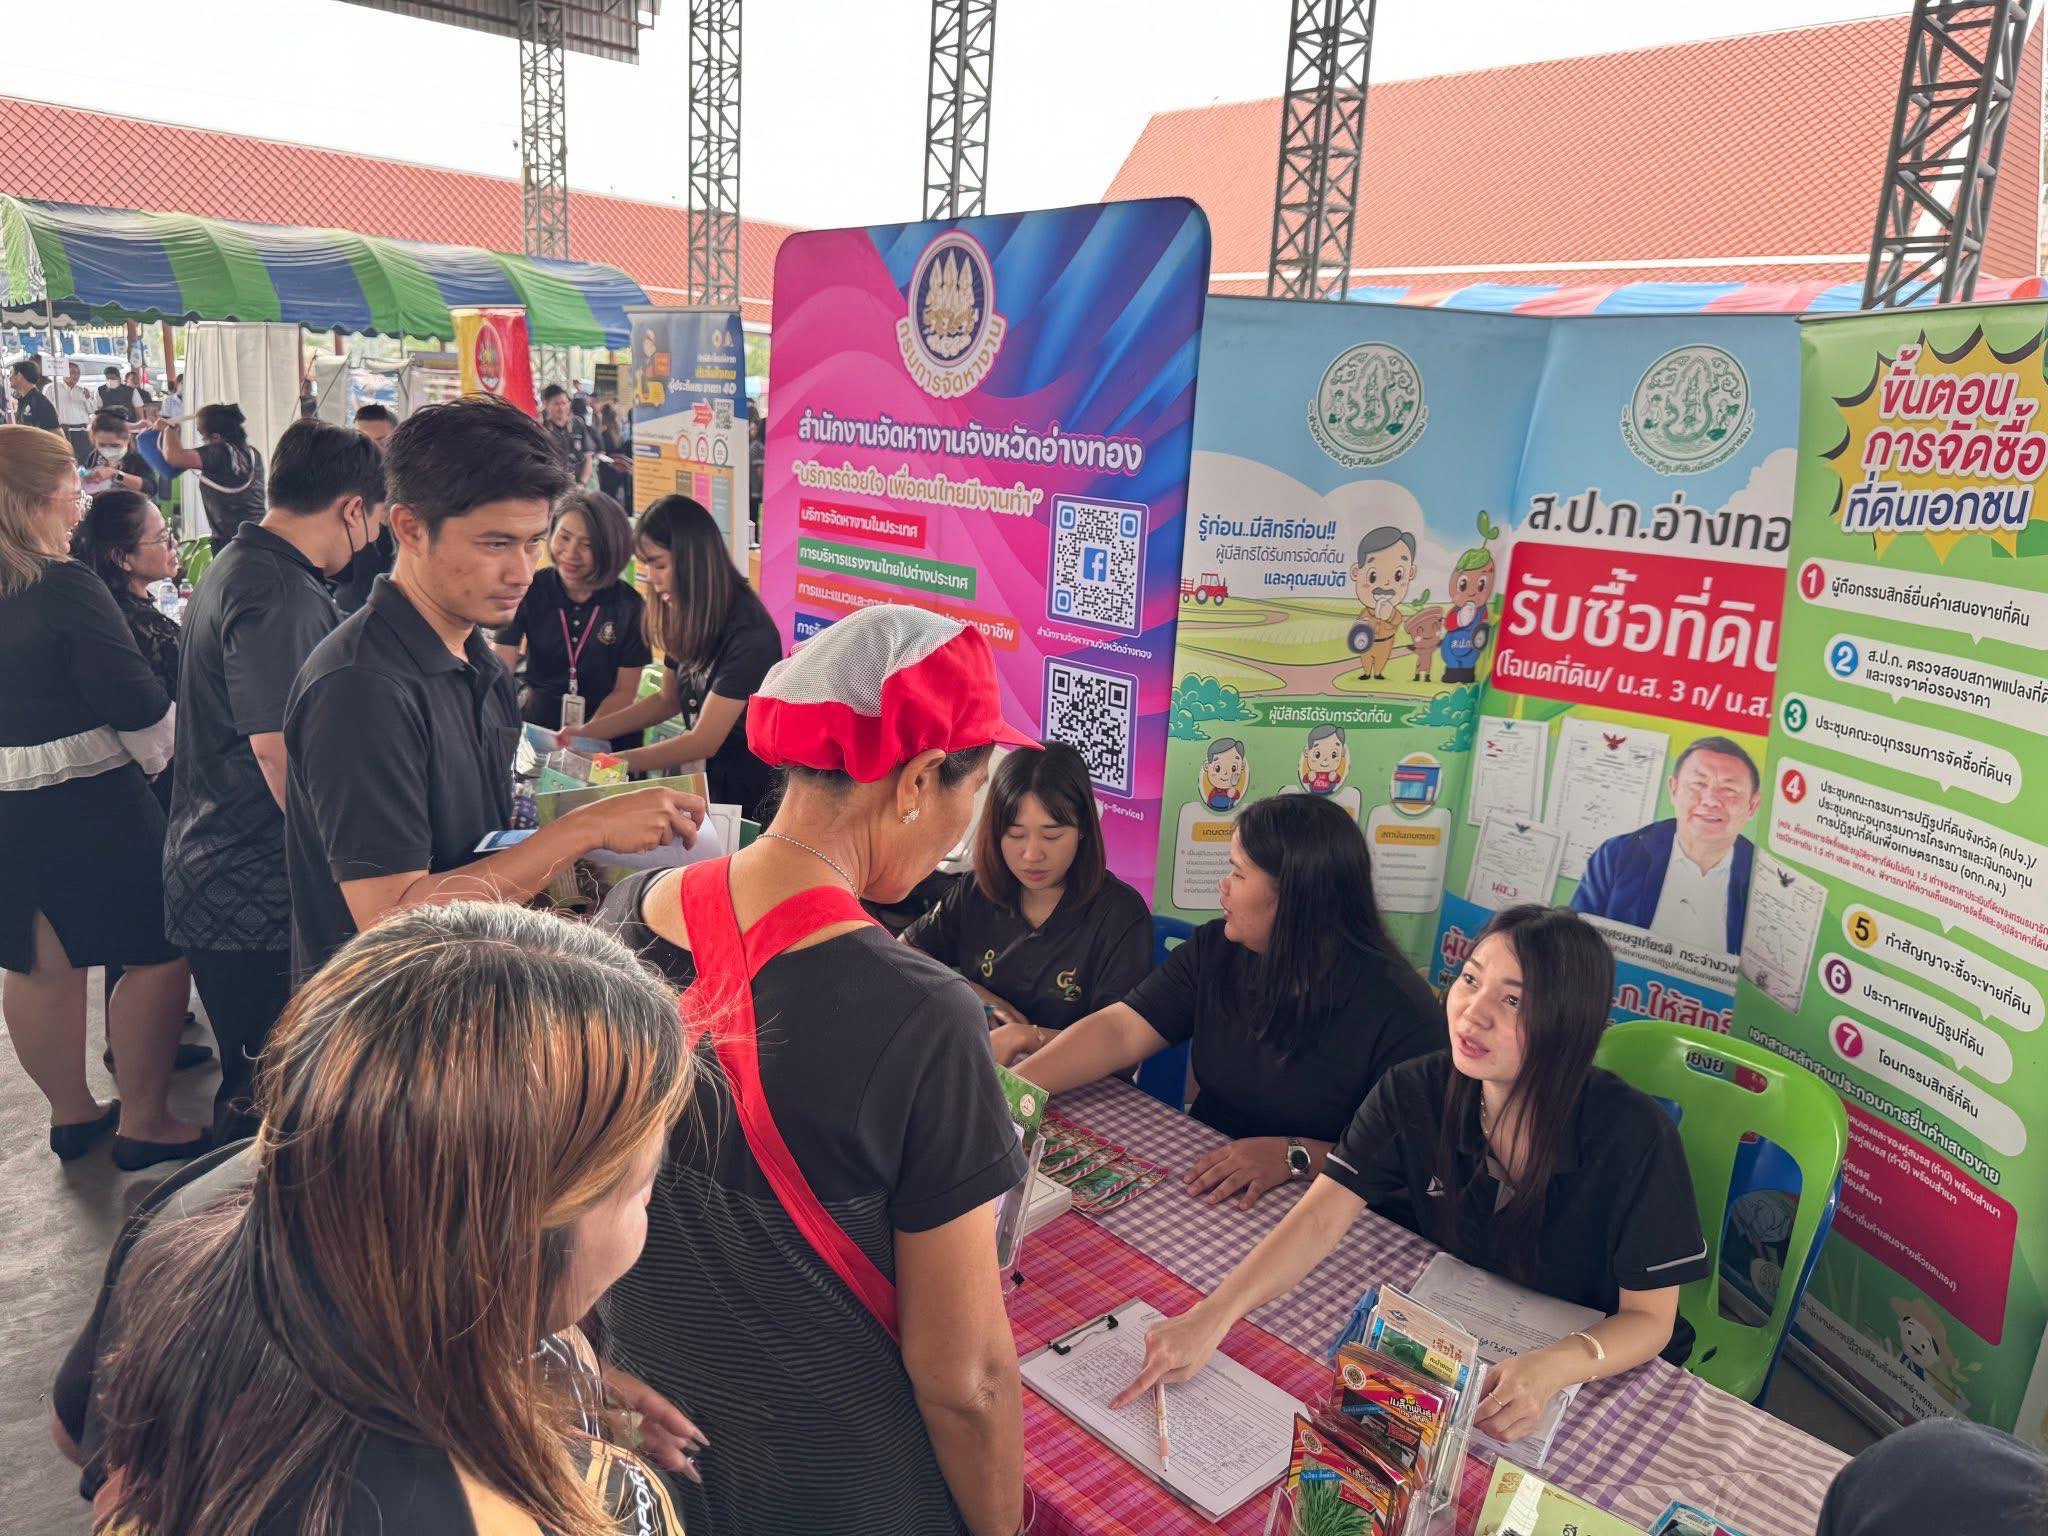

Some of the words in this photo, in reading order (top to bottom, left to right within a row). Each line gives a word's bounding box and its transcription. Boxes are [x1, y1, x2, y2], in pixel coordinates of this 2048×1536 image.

[1883, 350, 2015, 417] ขั้นตอน
[798, 410, 1143, 471] สำนักงานจัดหางานจังหวัดอ่างทอง
[1864, 404, 2047, 476] การจัดซื้อ
[800, 508, 919, 539] บริการจัดหางานในประเทศ
[1845, 471, 2030, 528] ที่ดินเอกชน
[1263, 570, 1347, 590] และคุณสมบัติ
[1807, 568, 1818, 594] 1
[1831, 576, 2030, 628] ผู้ถือกรรมสิทธิ์ยื่นคำเสนอขายที่ดิน
[1616, 672, 1662, 699] น.ส.
[1669, 679, 1685, 702] 3
[1836, 645, 1854, 673] 2
[1867, 650, 1903, 669] ส.ป.ก.
[1865, 668, 1991, 709] และเจรจาต่อรองราคา
[1788, 702, 1803, 728] 3
[1815, 715, 2013, 786] ประชุมคณะอนุกรรมการจัดซื้อที่ดินฯ
[1786, 774, 1802, 800] 4
[1816, 814, 1958, 873] การปฏิรูปที่ดินเพื่อเกษตรกรรม
[1855, 917, 1870, 941] 5
[1885, 932, 2032, 1016] ทำสัญญาจะซื้อจะขายที่ดิน
[1830, 963, 1846, 989] 6
[1863, 984, 1985, 1057] ประกาศเขตปฏิรูปที่ดิน
[1842, 1027, 1859, 1053] 7
[1878, 1048, 1979, 1119] โอนกรรมสิทธิ์ที่ดิน
